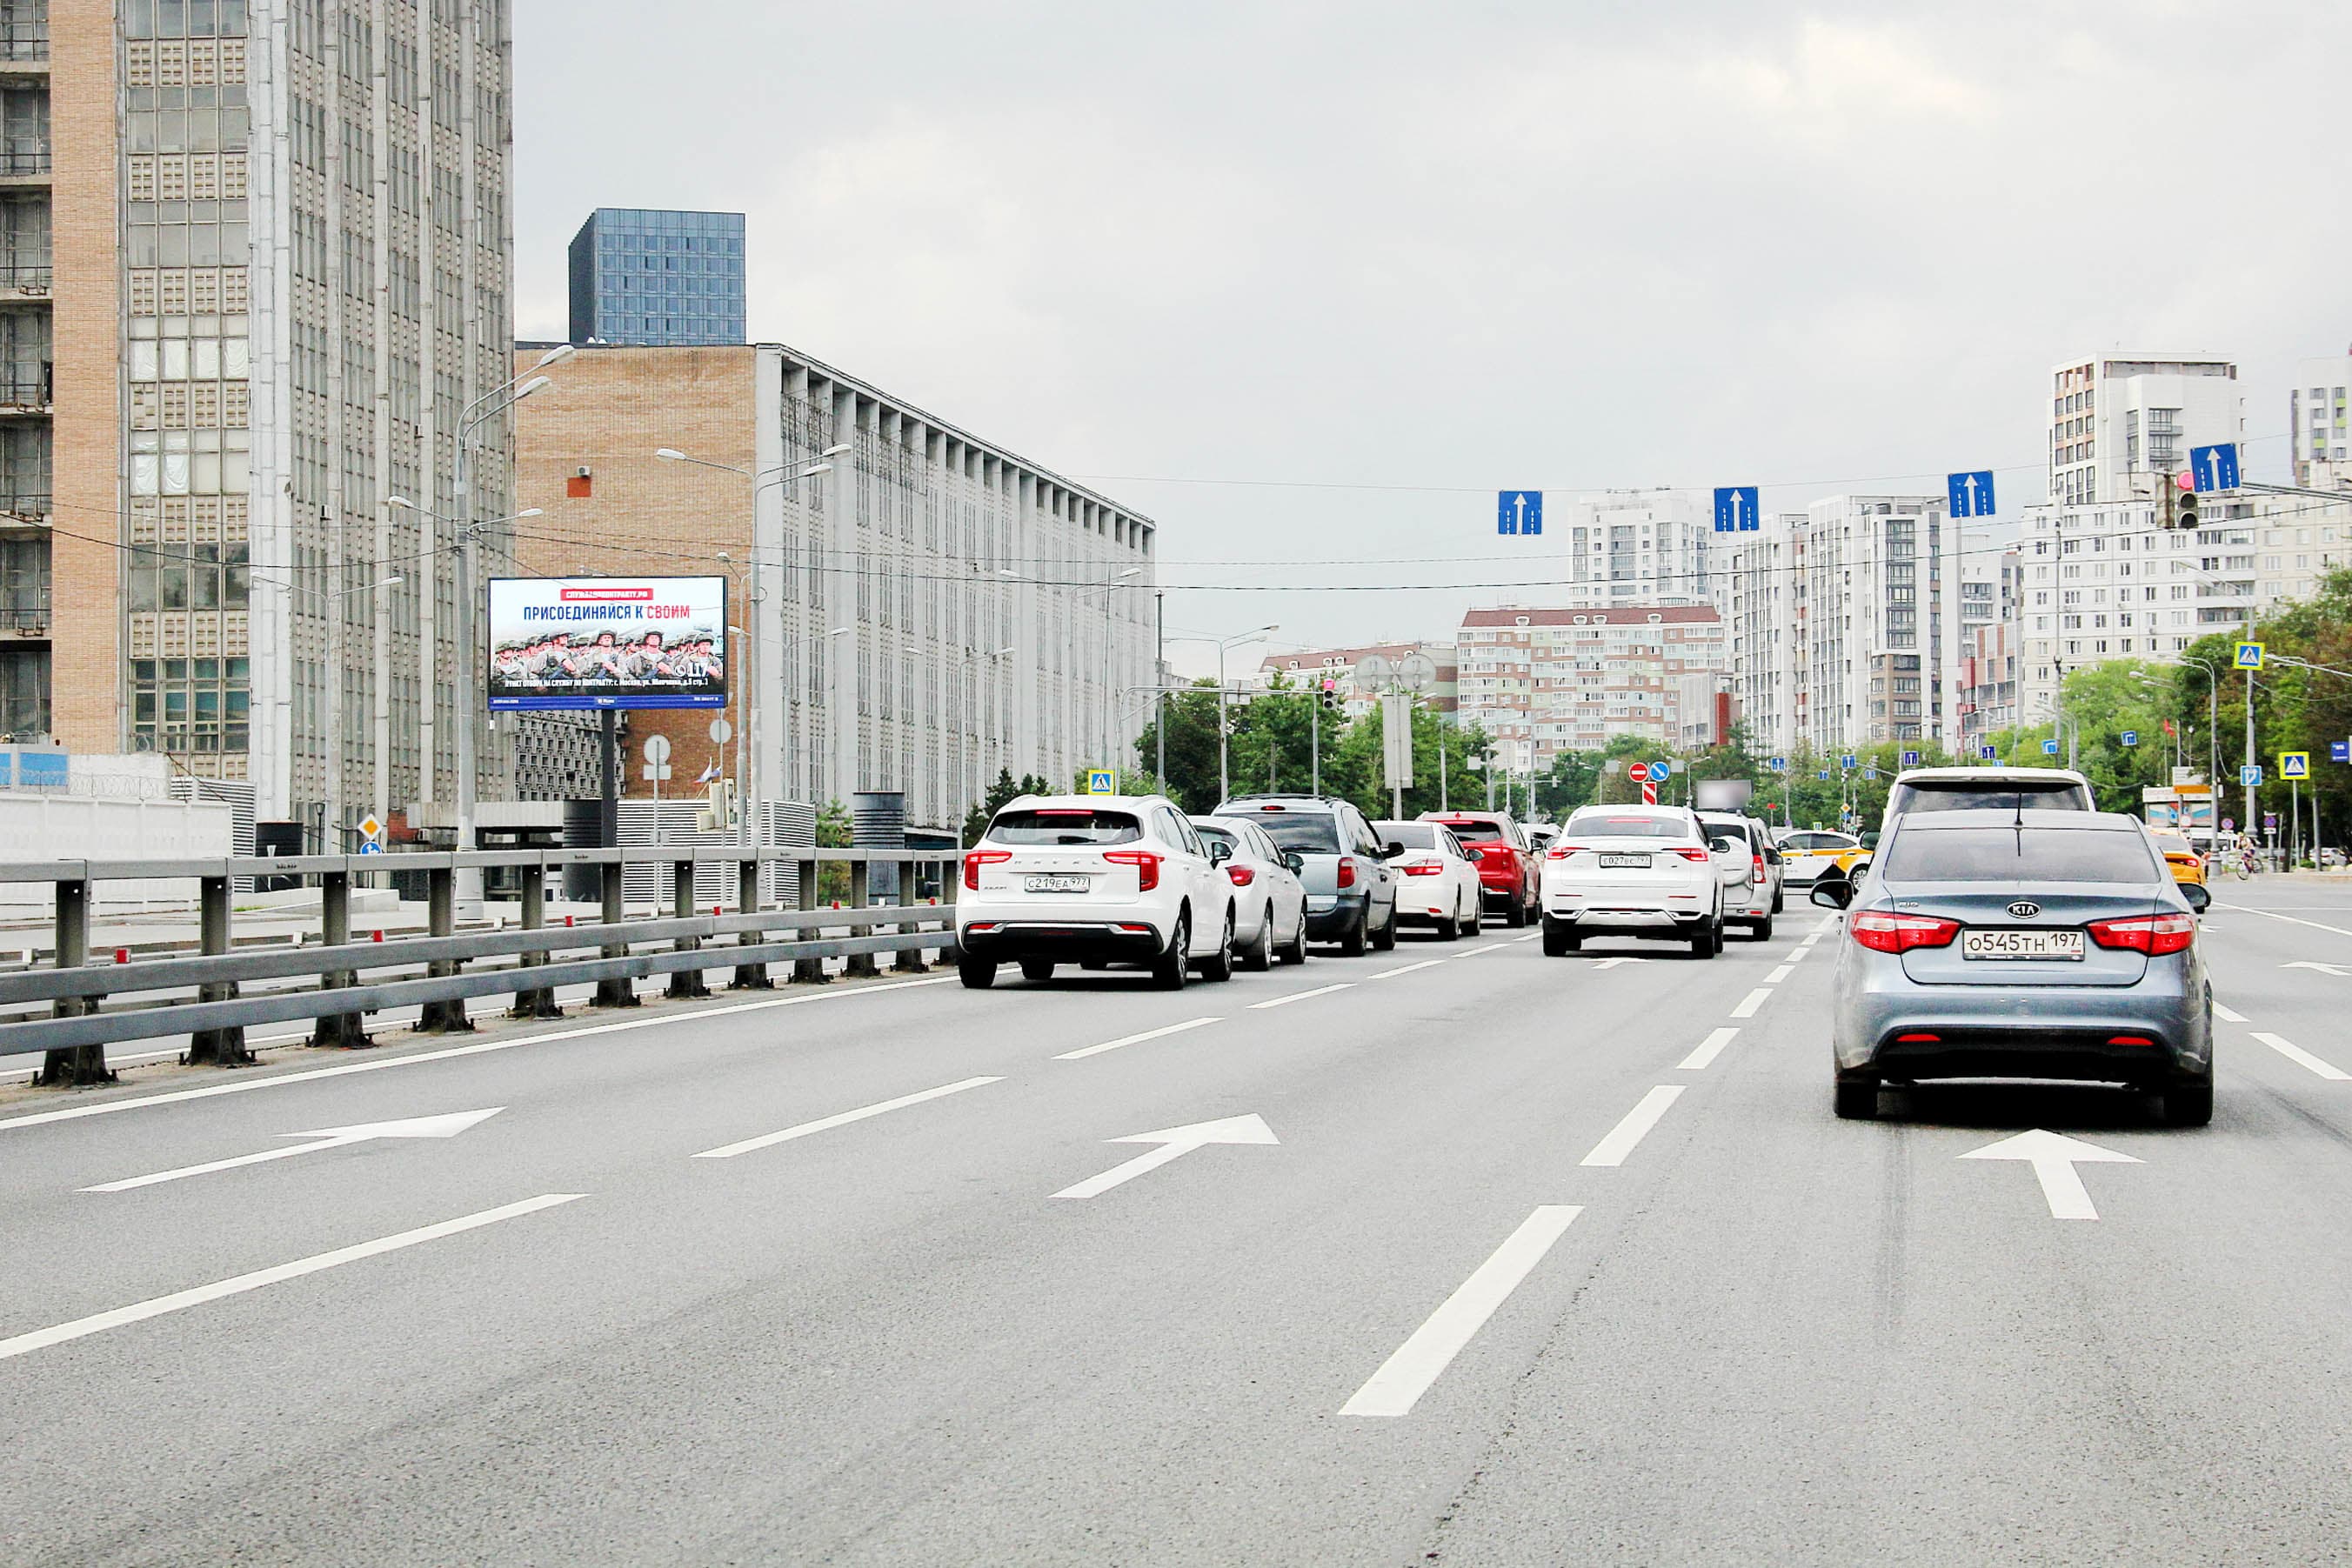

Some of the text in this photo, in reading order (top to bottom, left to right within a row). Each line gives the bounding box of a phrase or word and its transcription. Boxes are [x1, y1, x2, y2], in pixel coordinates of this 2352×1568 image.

[524, 603, 690, 621] ПРИСОЕДИНЯЙСЯ К СВОИМ
[687, 662, 708, 677] 117
[1028, 877, 1087, 889] С219ЕА 977
[2012, 905, 2035, 915] KIA
[1969, 933, 2078, 951] О545ТН 197
